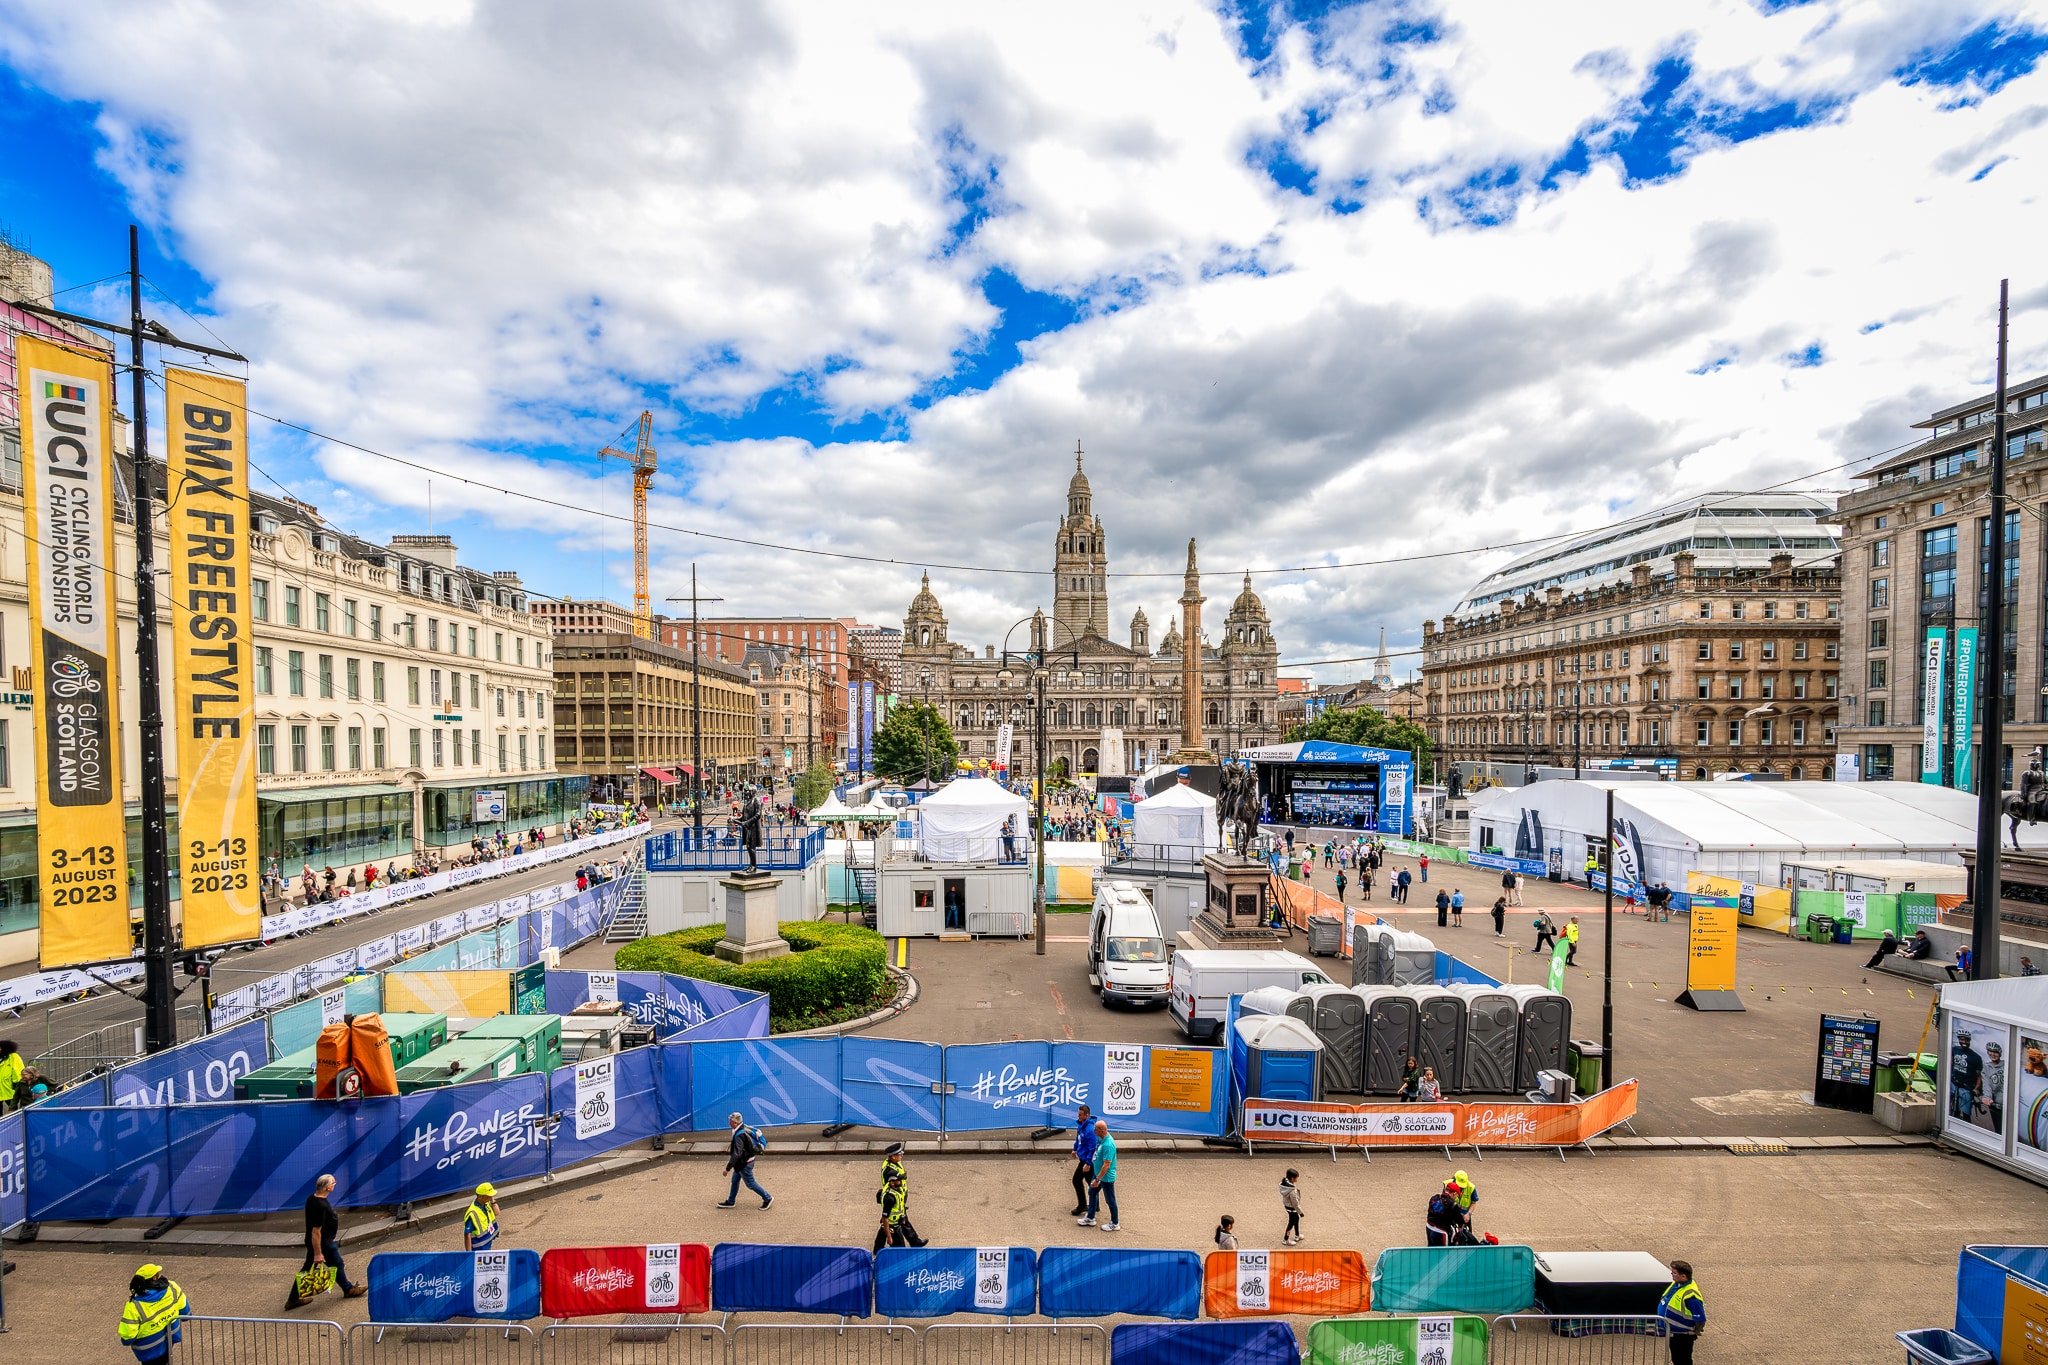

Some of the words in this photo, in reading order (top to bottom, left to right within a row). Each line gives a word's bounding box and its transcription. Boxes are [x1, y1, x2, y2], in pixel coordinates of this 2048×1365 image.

[45, 401, 88, 480] UCI
[184, 402, 234, 500] BMX
[71, 486, 91, 560] CYCLING
[49, 483, 70, 625] CHAMPIONSHIPS
[73, 560, 92, 625] WORLD
[186, 508, 240, 739] FREESTYLE
[1929, 647, 1938, 671] UCI
[1955, 638, 1971, 751] #POWEROFTHEBIKE
[57, 703, 76, 792] SCOTLAND
[78, 703, 100, 792] GLASGOW
[1244, 751, 1260, 759] UCI
[190, 837, 247, 859] 3-13
[51, 845, 115, 869] 3-13
[506, 857, 530, 868] SCOTLAND
[190, 859, 248, 874] AUGUST
[51, 868, 117, 884] AUGUST
[453, 868, 483, 881] SCOTLAND
[191, 874, 248, 894] 2023
[392, 882, 426, 898] SCOTLAND
[1696, 884, 1730, 897] #POWER
[53, 885, 118, 907] 2023
[265, 927, 277, 935] Peter
[277, 923, 291, 933] Vardy
[113, 966, 132, 977] Vardy
[35, 985, 56, 997] Peter
[58, 980, 80, 991] Vardy
[1836, 1022, 1865, 1030] GLASGOW
[1833, 1030, 1866, 1038] WELCOME
[1114, 1051, 1139, 1061] UCI
[585, 1063, 611, 1079] UCI
[994, 1097, 1012, 1110] OF
[1016, 1092, 1037, 1104] THE
[1263, 1113, 1298, 1127] UCI
[1301, 1115, 1336, 1124] CYCLING
[1301, 1123, 1368, 1131] CHAMPIONSHIPS
[581, 1122, 611, 1135] SCOTLAND
[1491, 1127, 1505, 1136] THE
[465, 1139, 496, 1160] THE
[483, 1256, 506, 1265] UCI
[654, 1249, 677, 1259] UCI
[984, 1252, 1006, 1262] UCI
[1245, 1255, 1267, 1264] UCI
[1426, 1323, 1450, 1332] UCI
